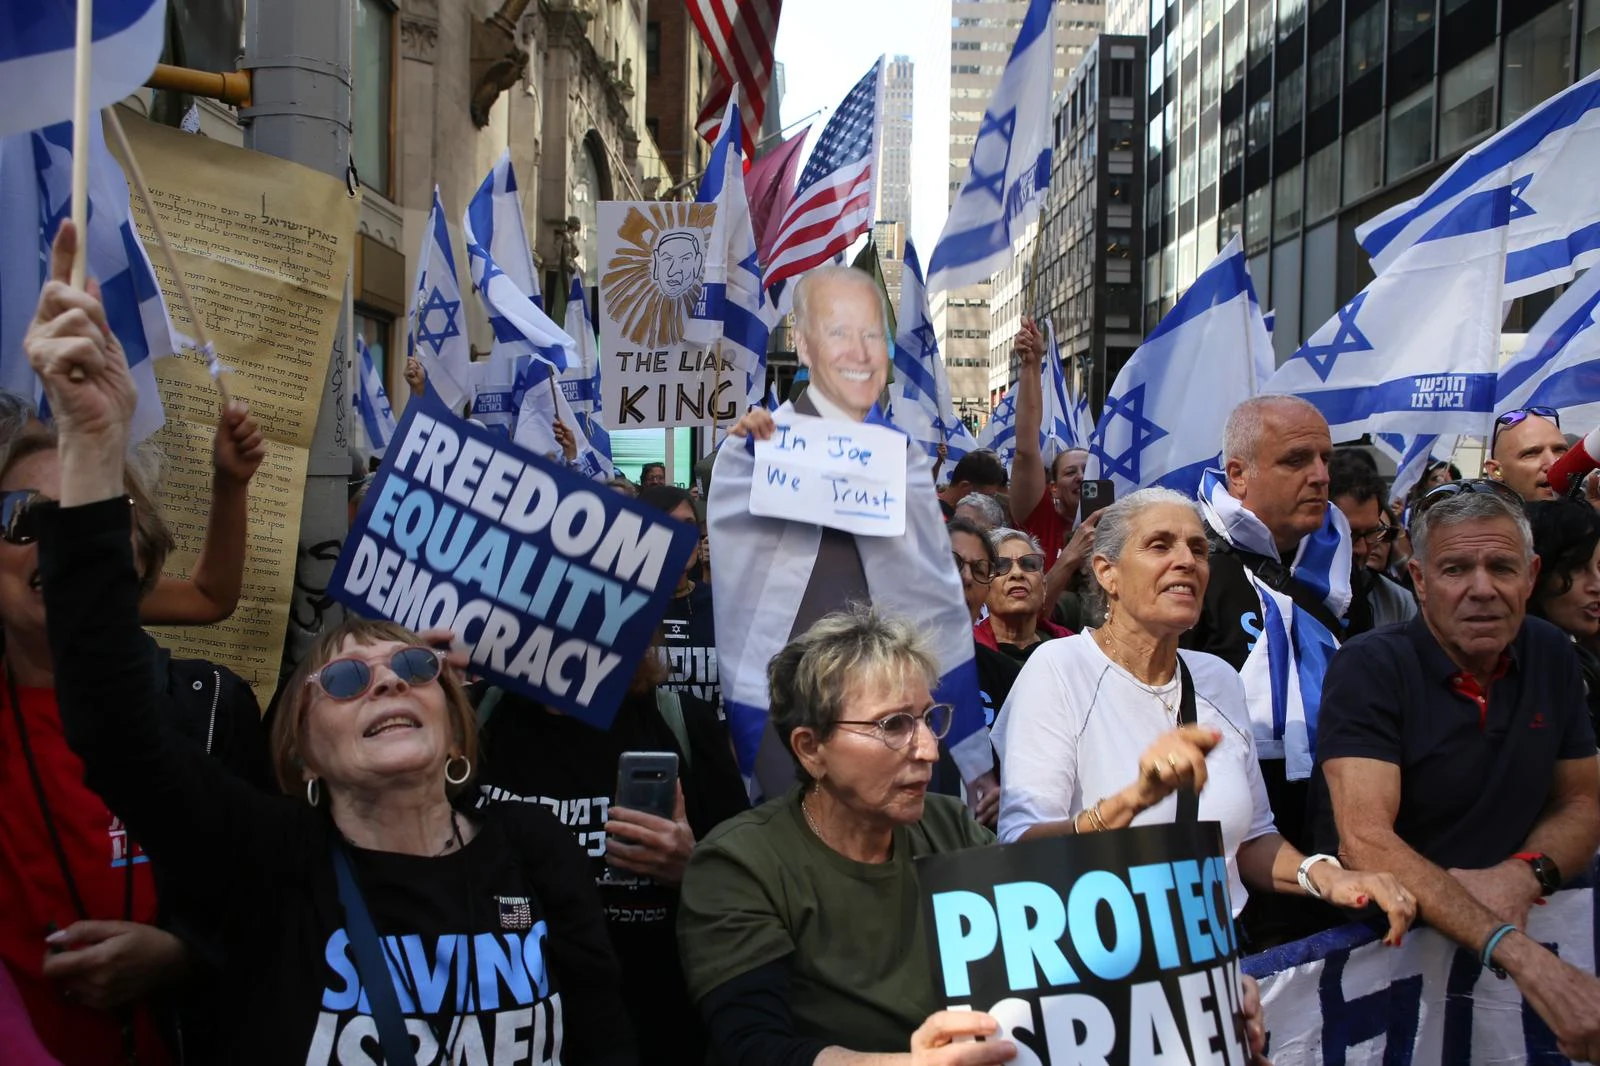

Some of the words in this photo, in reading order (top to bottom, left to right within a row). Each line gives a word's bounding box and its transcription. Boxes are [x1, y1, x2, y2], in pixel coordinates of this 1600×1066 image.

[616, 351, 668, 373] THE
[1415, 376, 1466, 392] חופשי
[619, 380, 737, 424] KING
[1411, 391, 1464, 408] בארצנו
[774, 424, 806, 451] In
[827, 435, 872, 466] Joe
[394, 411, 674, 592] FREEDOM
[767, 463, 800, 492] We
[832, 477, 897, 511] Trust
[367, 473, 651, 647] EQUALITY
[344, 534, 623, 708] DEMOCRACY
